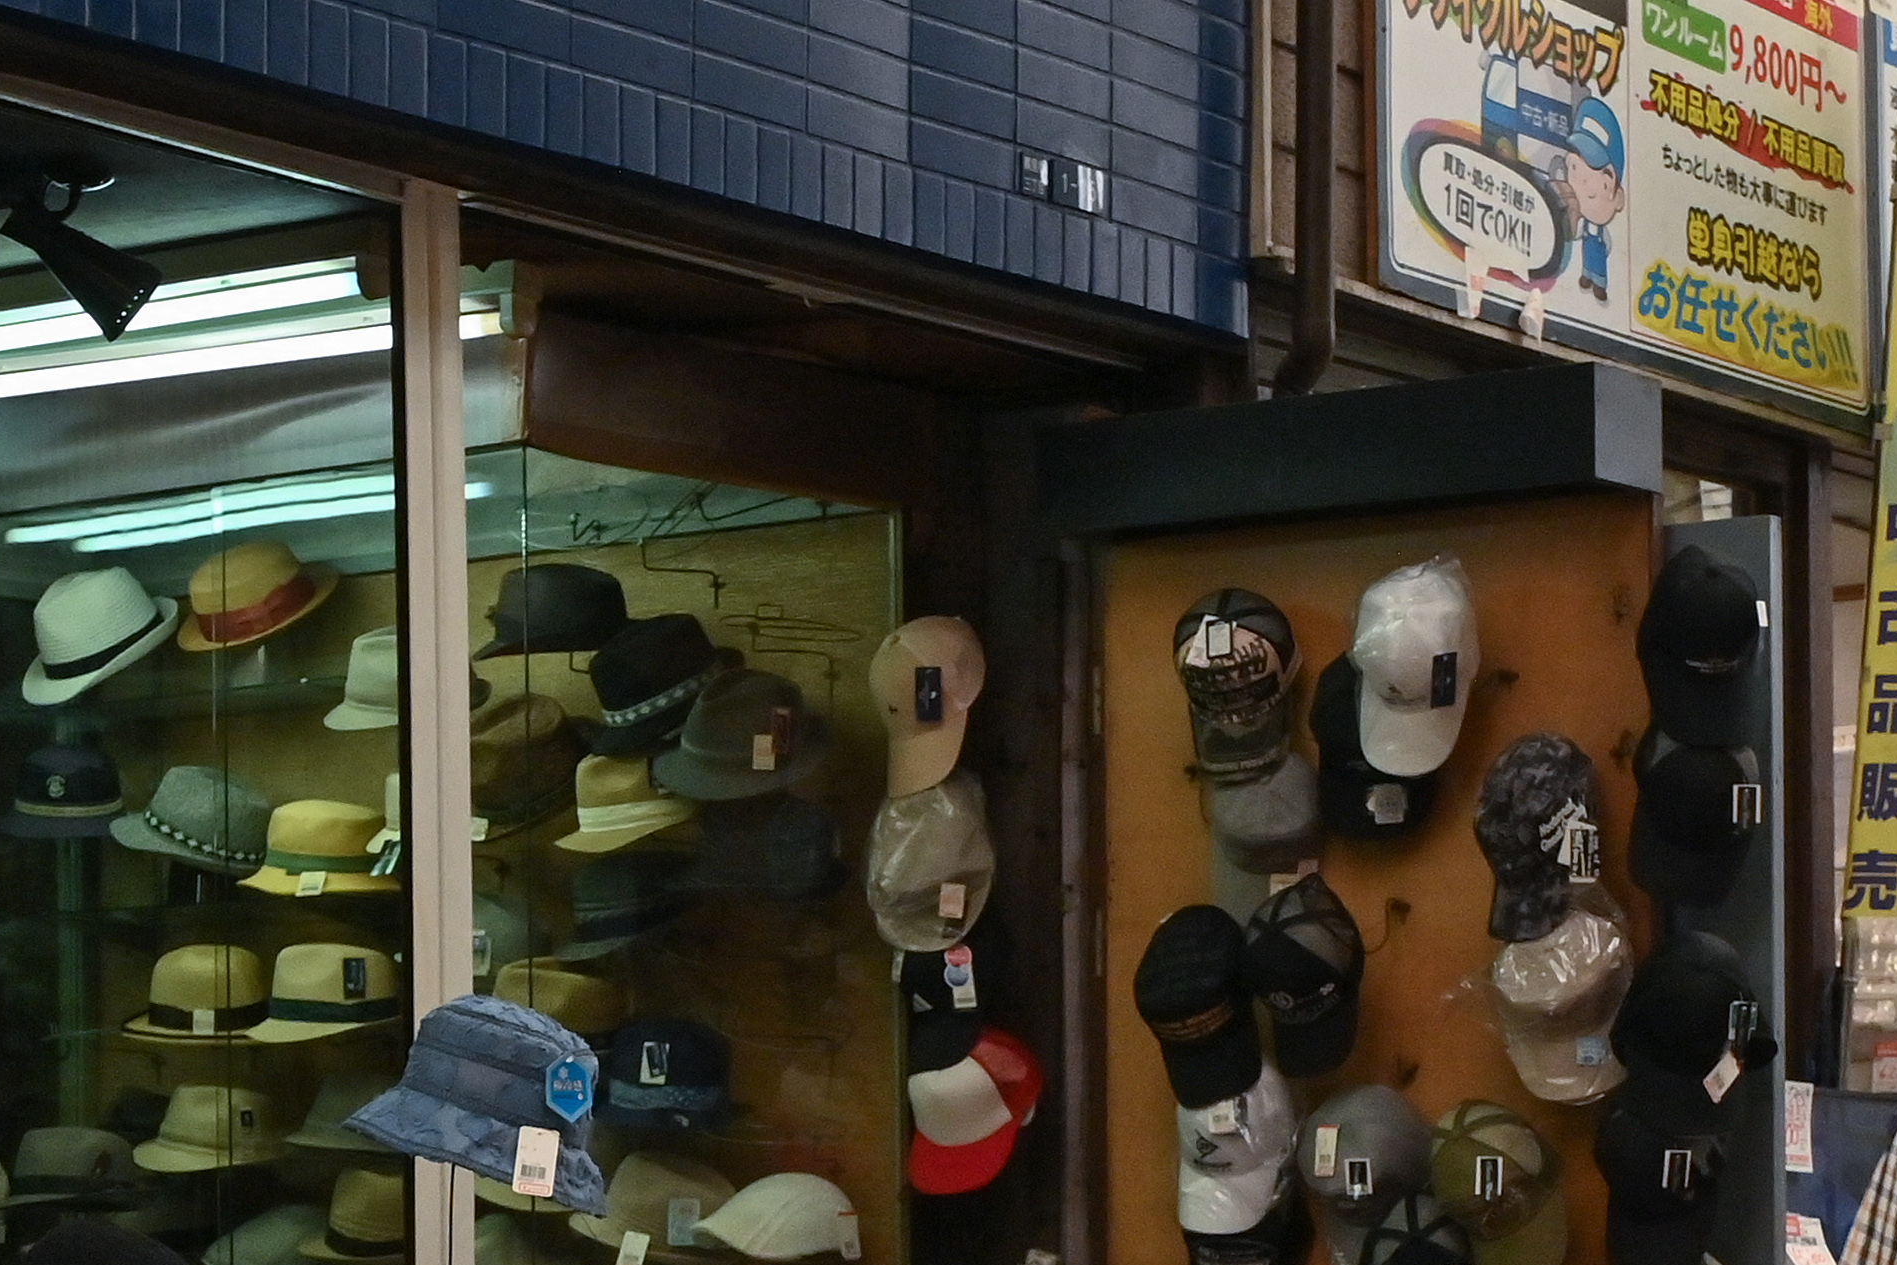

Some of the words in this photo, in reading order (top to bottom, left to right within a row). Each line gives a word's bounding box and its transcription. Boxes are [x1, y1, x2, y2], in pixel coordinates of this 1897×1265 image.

[1649, 69, 1741, 142] 不用品処分
[1761, 114, 1845, 183] 不用品買取
[1687, 206, 1822, 302] 単身引越なら
